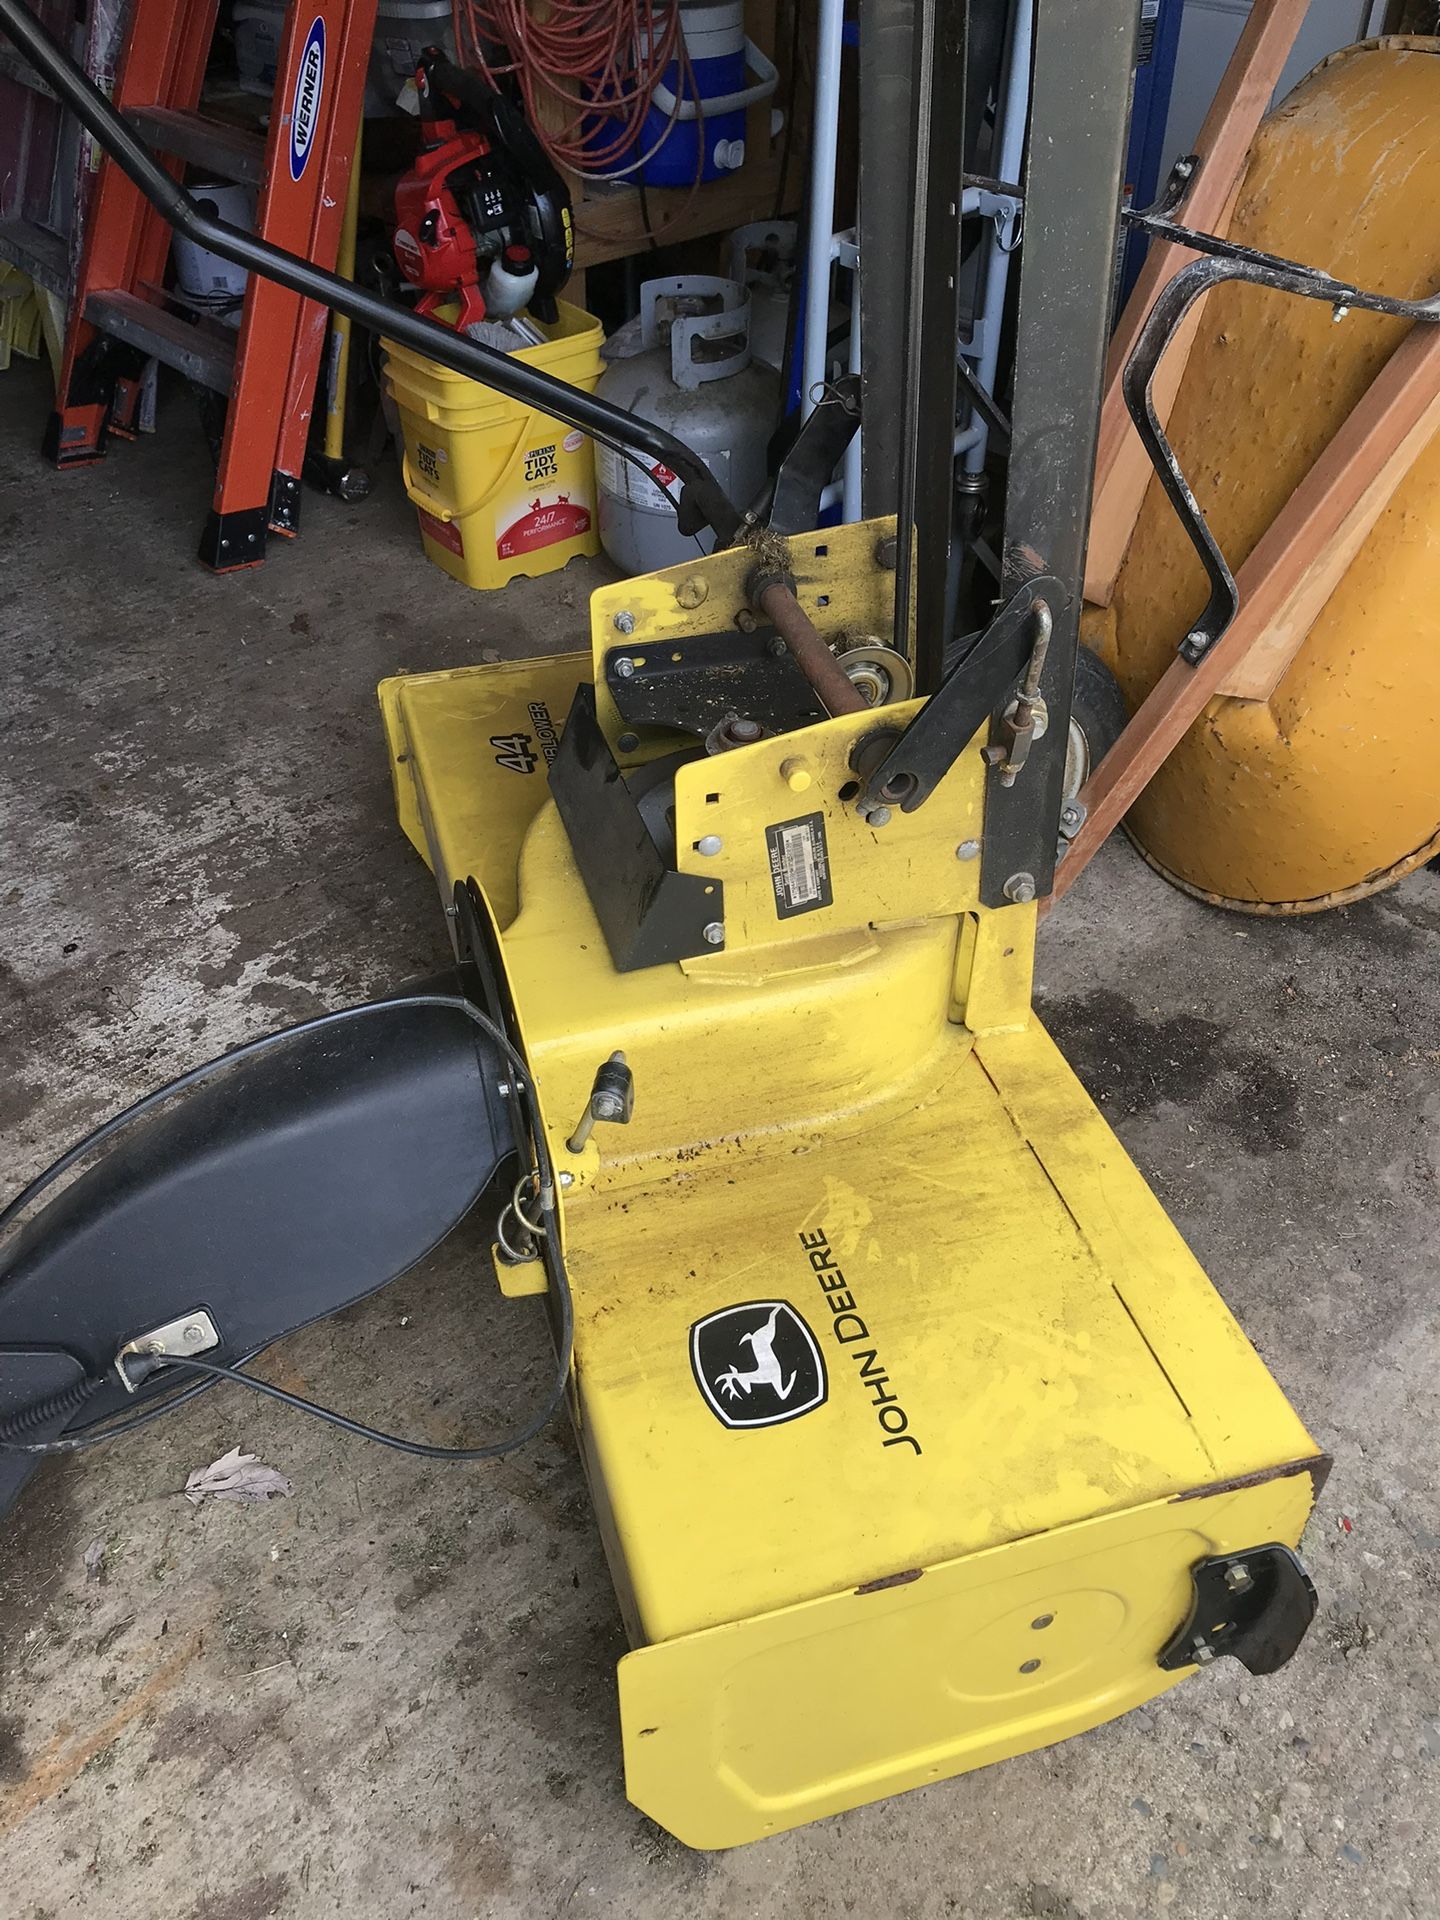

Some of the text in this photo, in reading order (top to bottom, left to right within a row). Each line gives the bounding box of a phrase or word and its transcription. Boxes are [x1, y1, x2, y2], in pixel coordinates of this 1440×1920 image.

[296, 50, 319, 147] WERNER
[417, 449, 437, 468] TIDY
[524, 453, 556, 470] TIDY
[525, 463, 558, 481] CATS
[523, 518, 566, 536] PERFORMANCE
[534, 511, 556, 528] 24/7
[489, 733, 538, 774] 44
[771, 847, 783, 897] JOHN DEERE
[799, 1228, 922, 1456] JOHN DEERE
